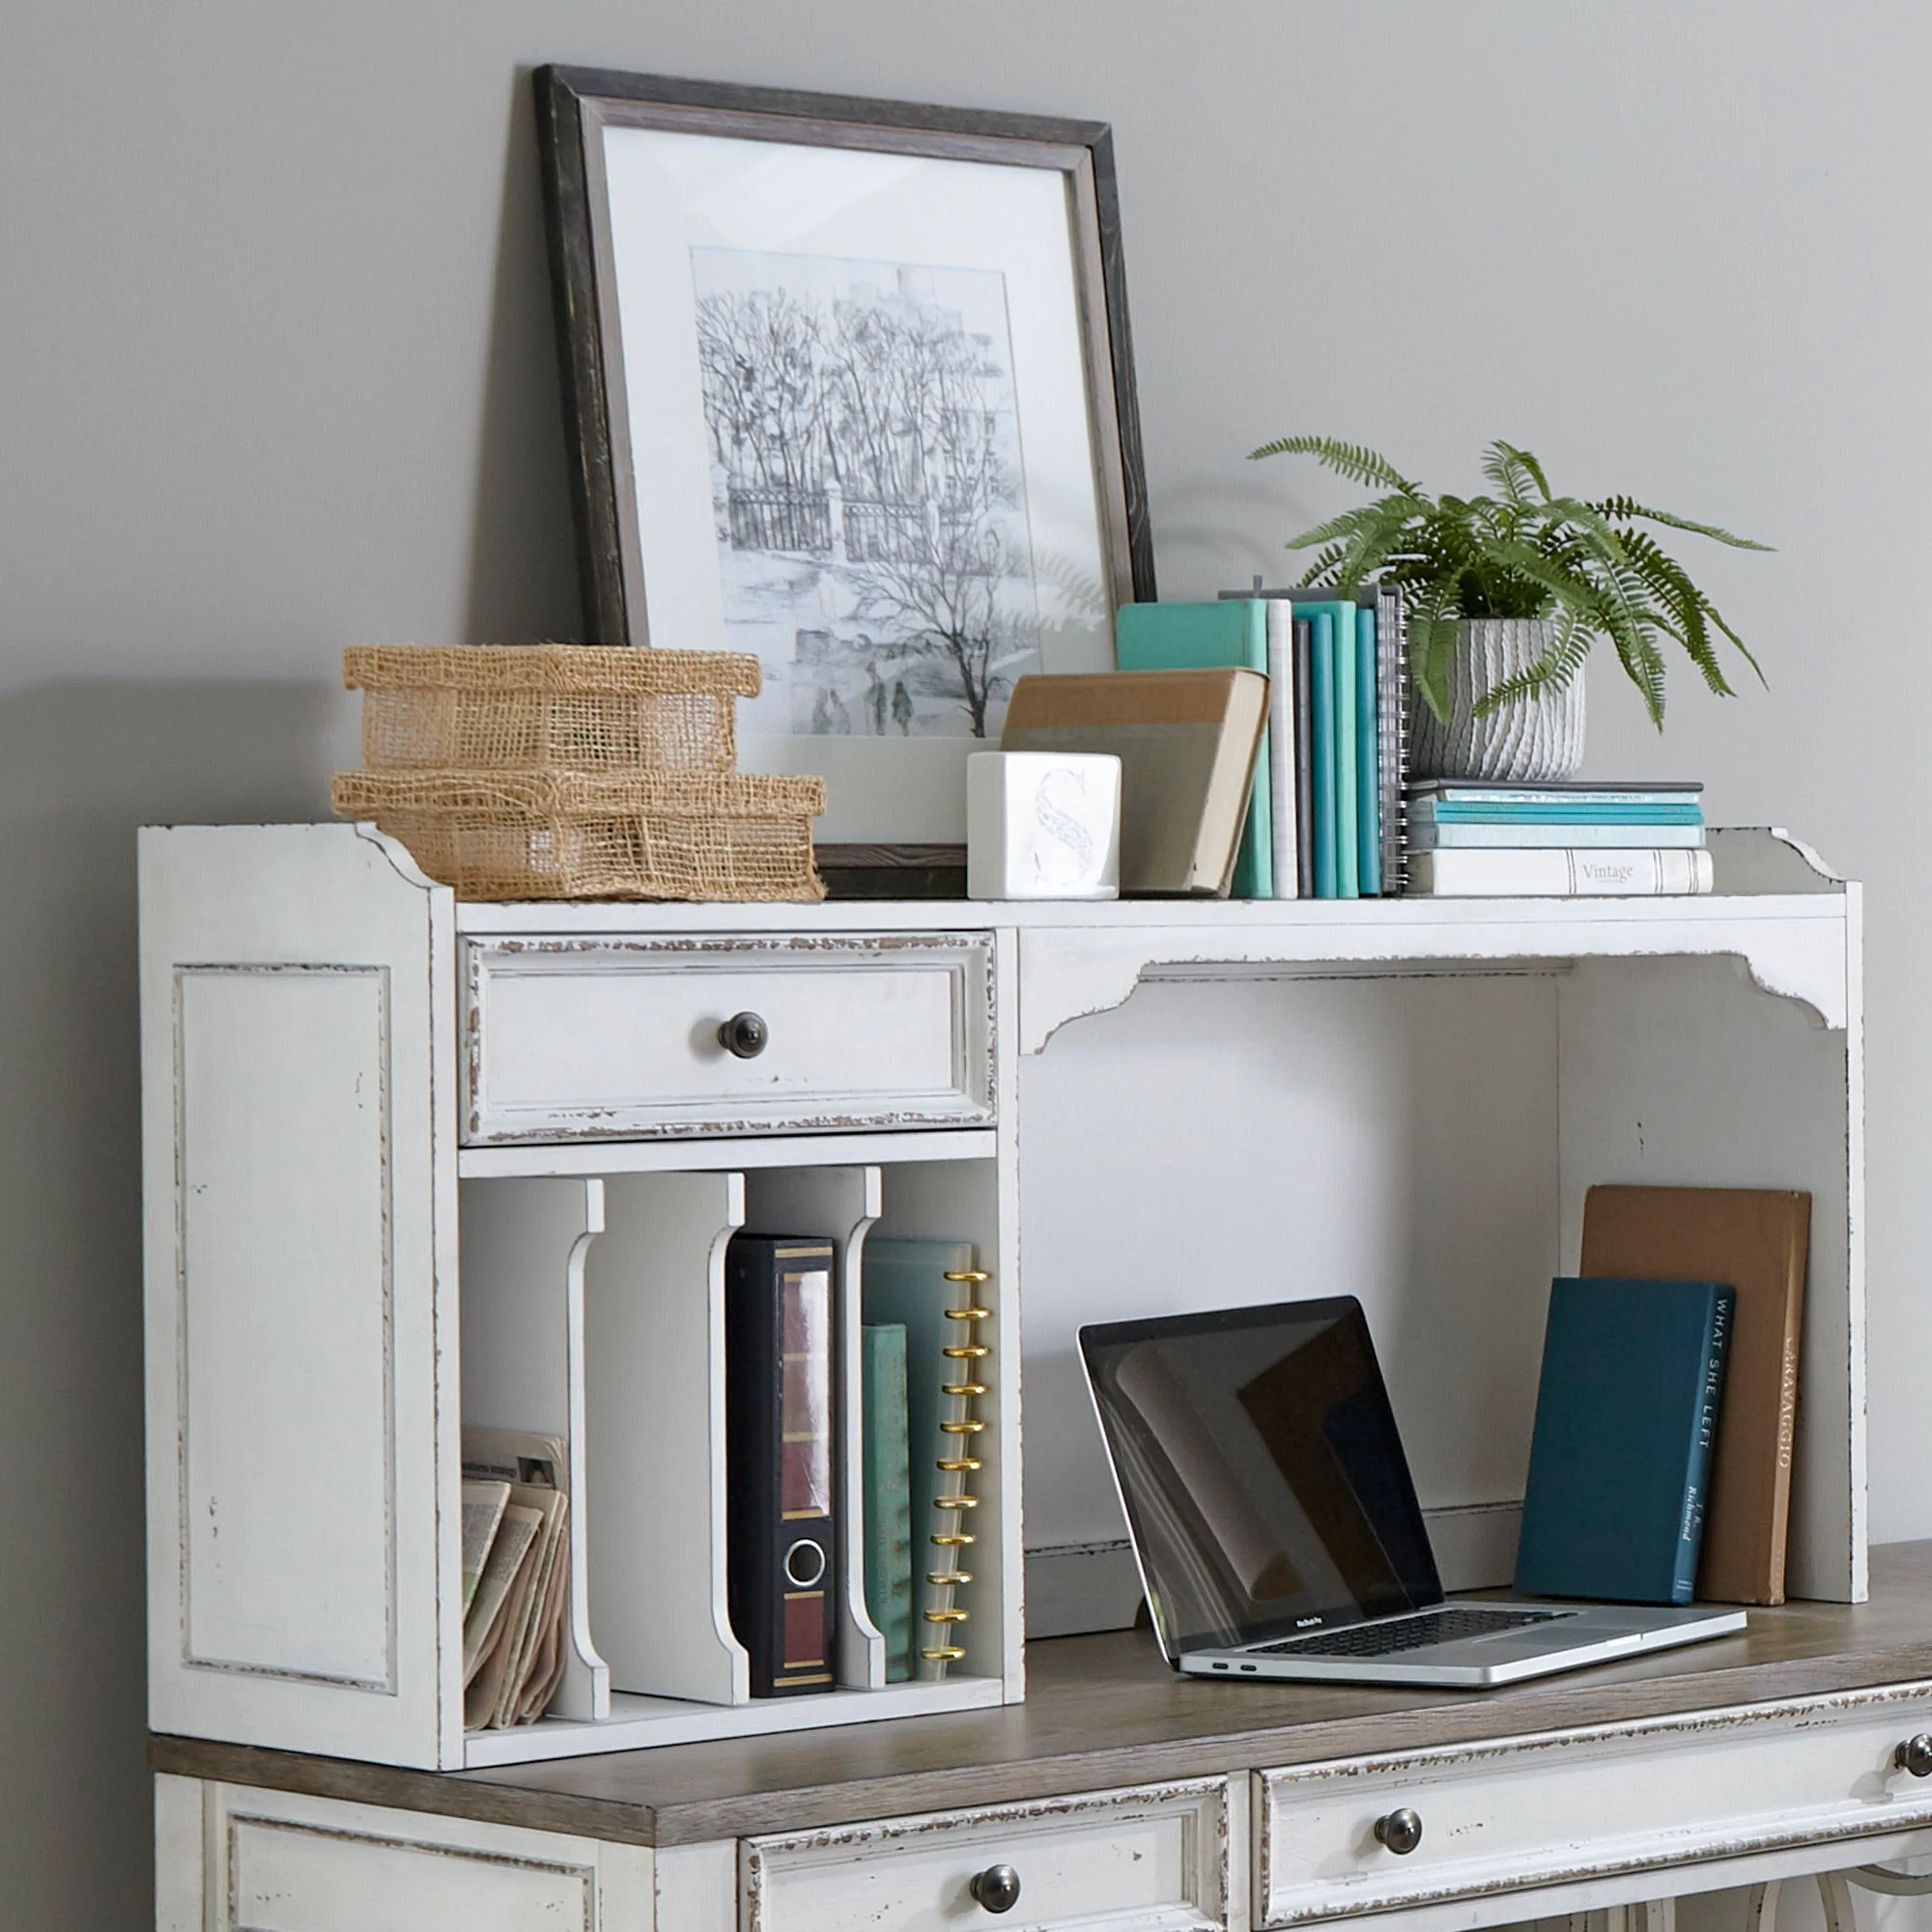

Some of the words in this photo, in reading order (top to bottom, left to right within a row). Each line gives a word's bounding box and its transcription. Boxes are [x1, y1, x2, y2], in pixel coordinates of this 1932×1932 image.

[1033, 767, 1094, 888] S
[1582, 863, 1634, 884] Vintage
[1712, 1298, 1727, 1349] WHAT
[1705, 1358, 1719, 1395] SHE
[1778, 1337, 1794, 1467] CARAVAGGIO
[1699, 1405, 1713, 1448] LEFT
[1683, 1486, 1697, 1541] Richmond
